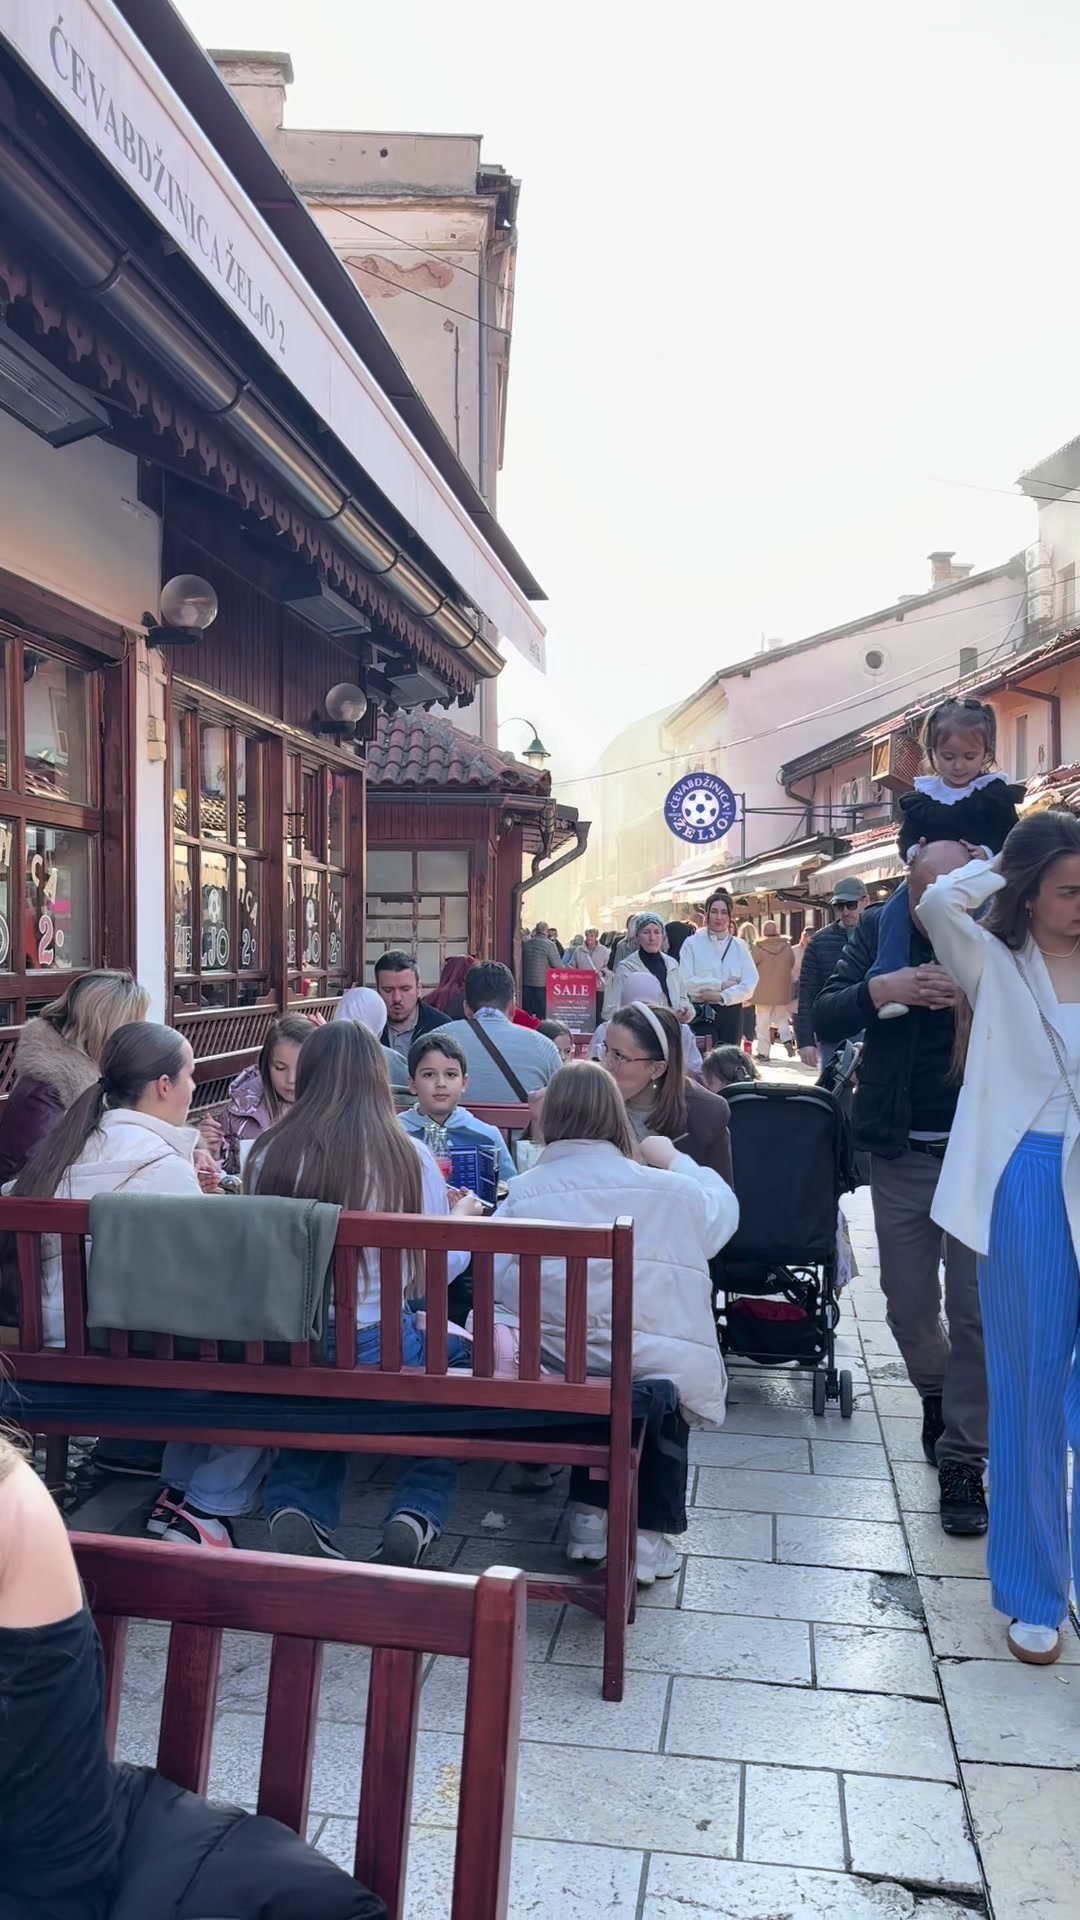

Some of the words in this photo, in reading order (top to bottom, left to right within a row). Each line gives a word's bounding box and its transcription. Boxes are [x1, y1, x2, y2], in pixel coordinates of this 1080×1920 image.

[225, 238, 277, 340] ŽELJO
[278, 319, 287, 356] 2
[673, 817, 728, 841] ŽELJO
[553, 983, 590, 997] SALE
